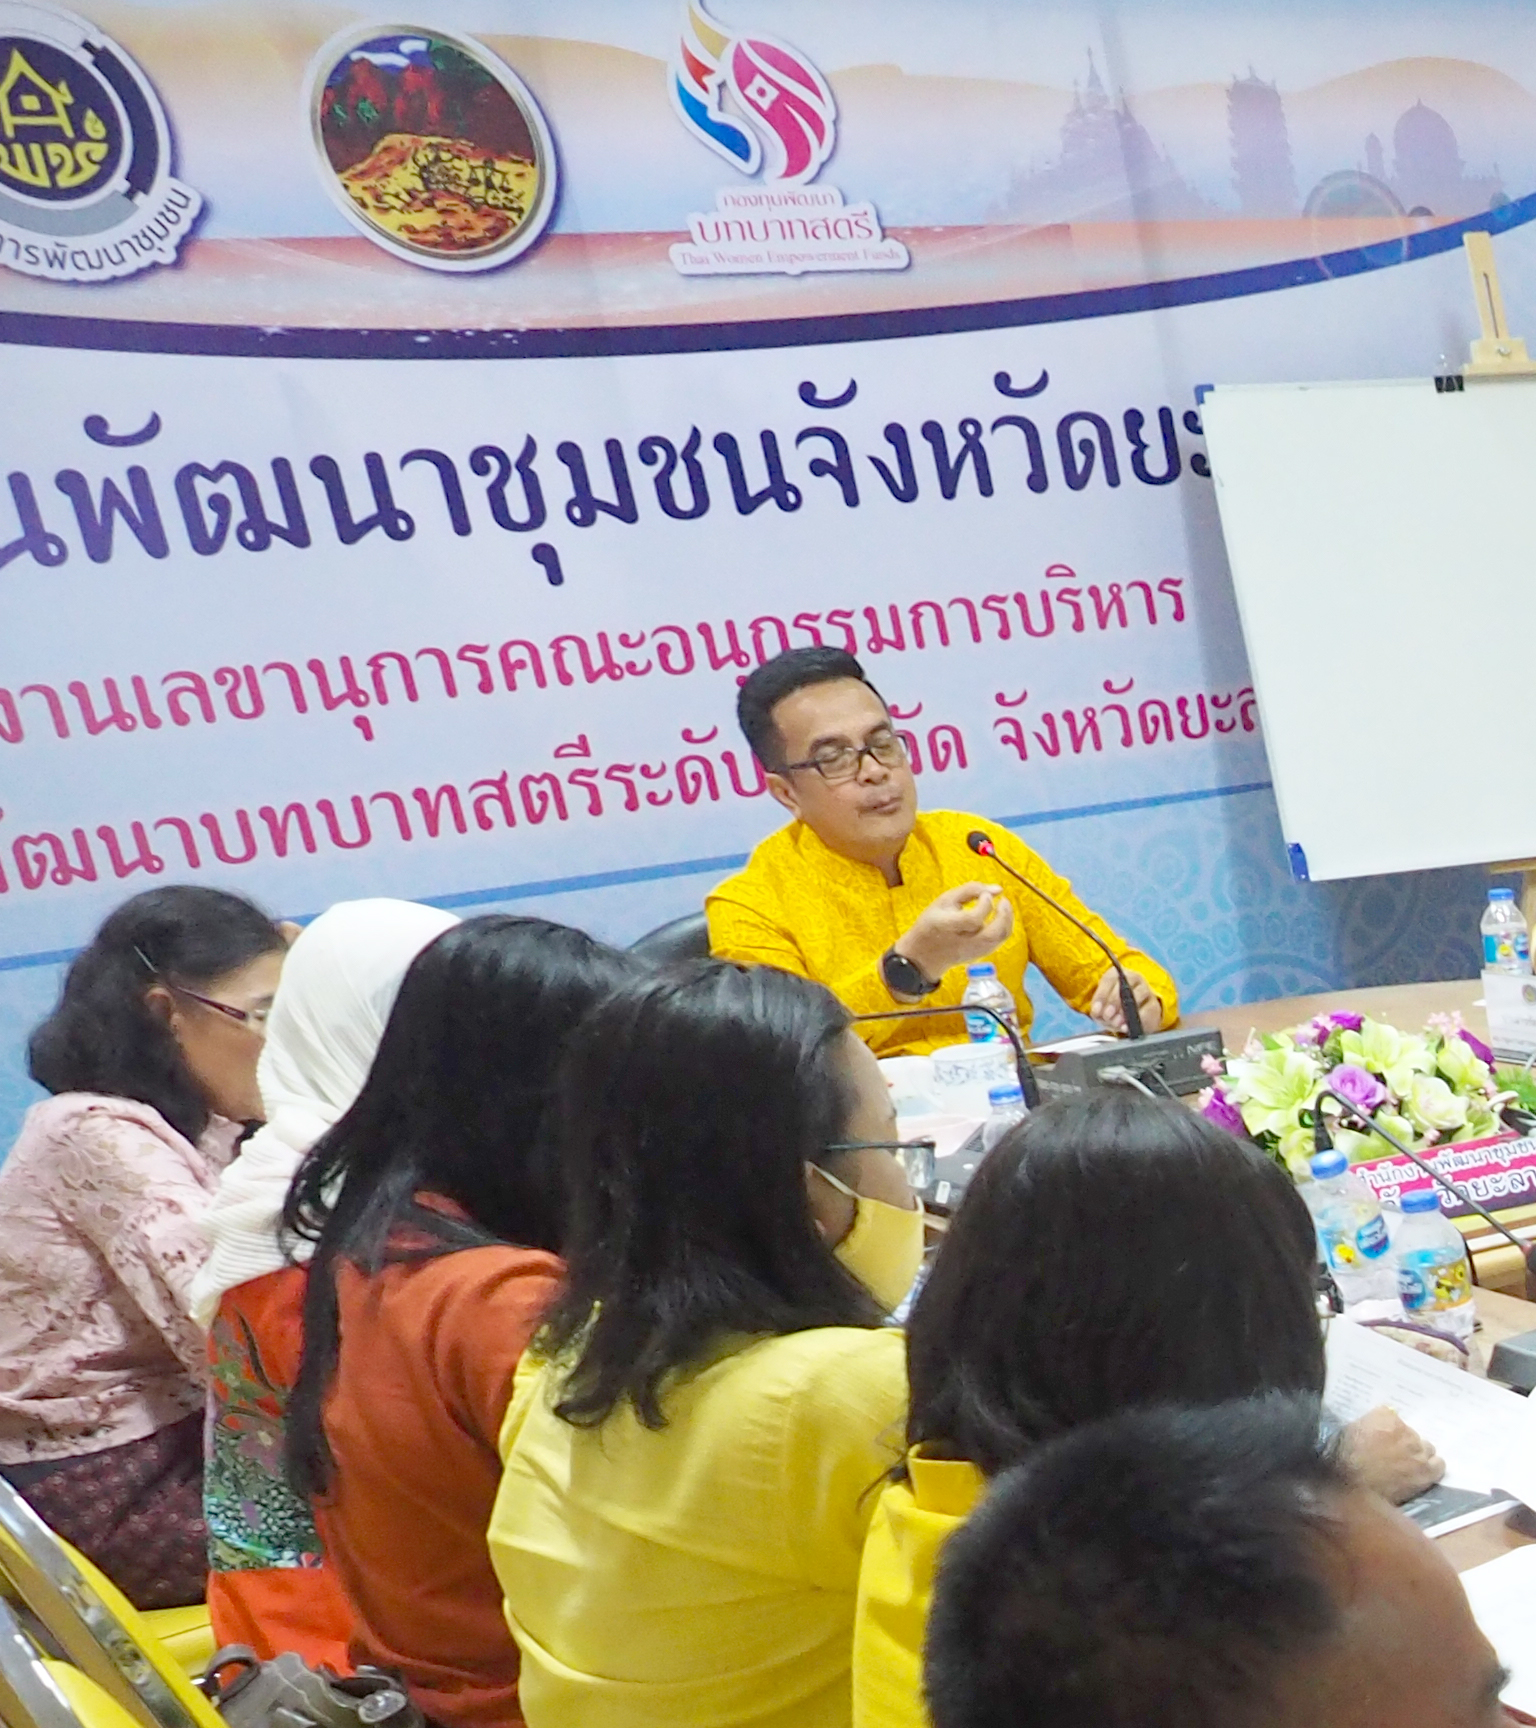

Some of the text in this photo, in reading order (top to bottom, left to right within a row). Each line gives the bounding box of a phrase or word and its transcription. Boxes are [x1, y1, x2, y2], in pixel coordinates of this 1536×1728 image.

[0, 187, 193, 272] ารพัฒนาชุมชน
[697, 210, 874, 243] บทบาทสตรี
